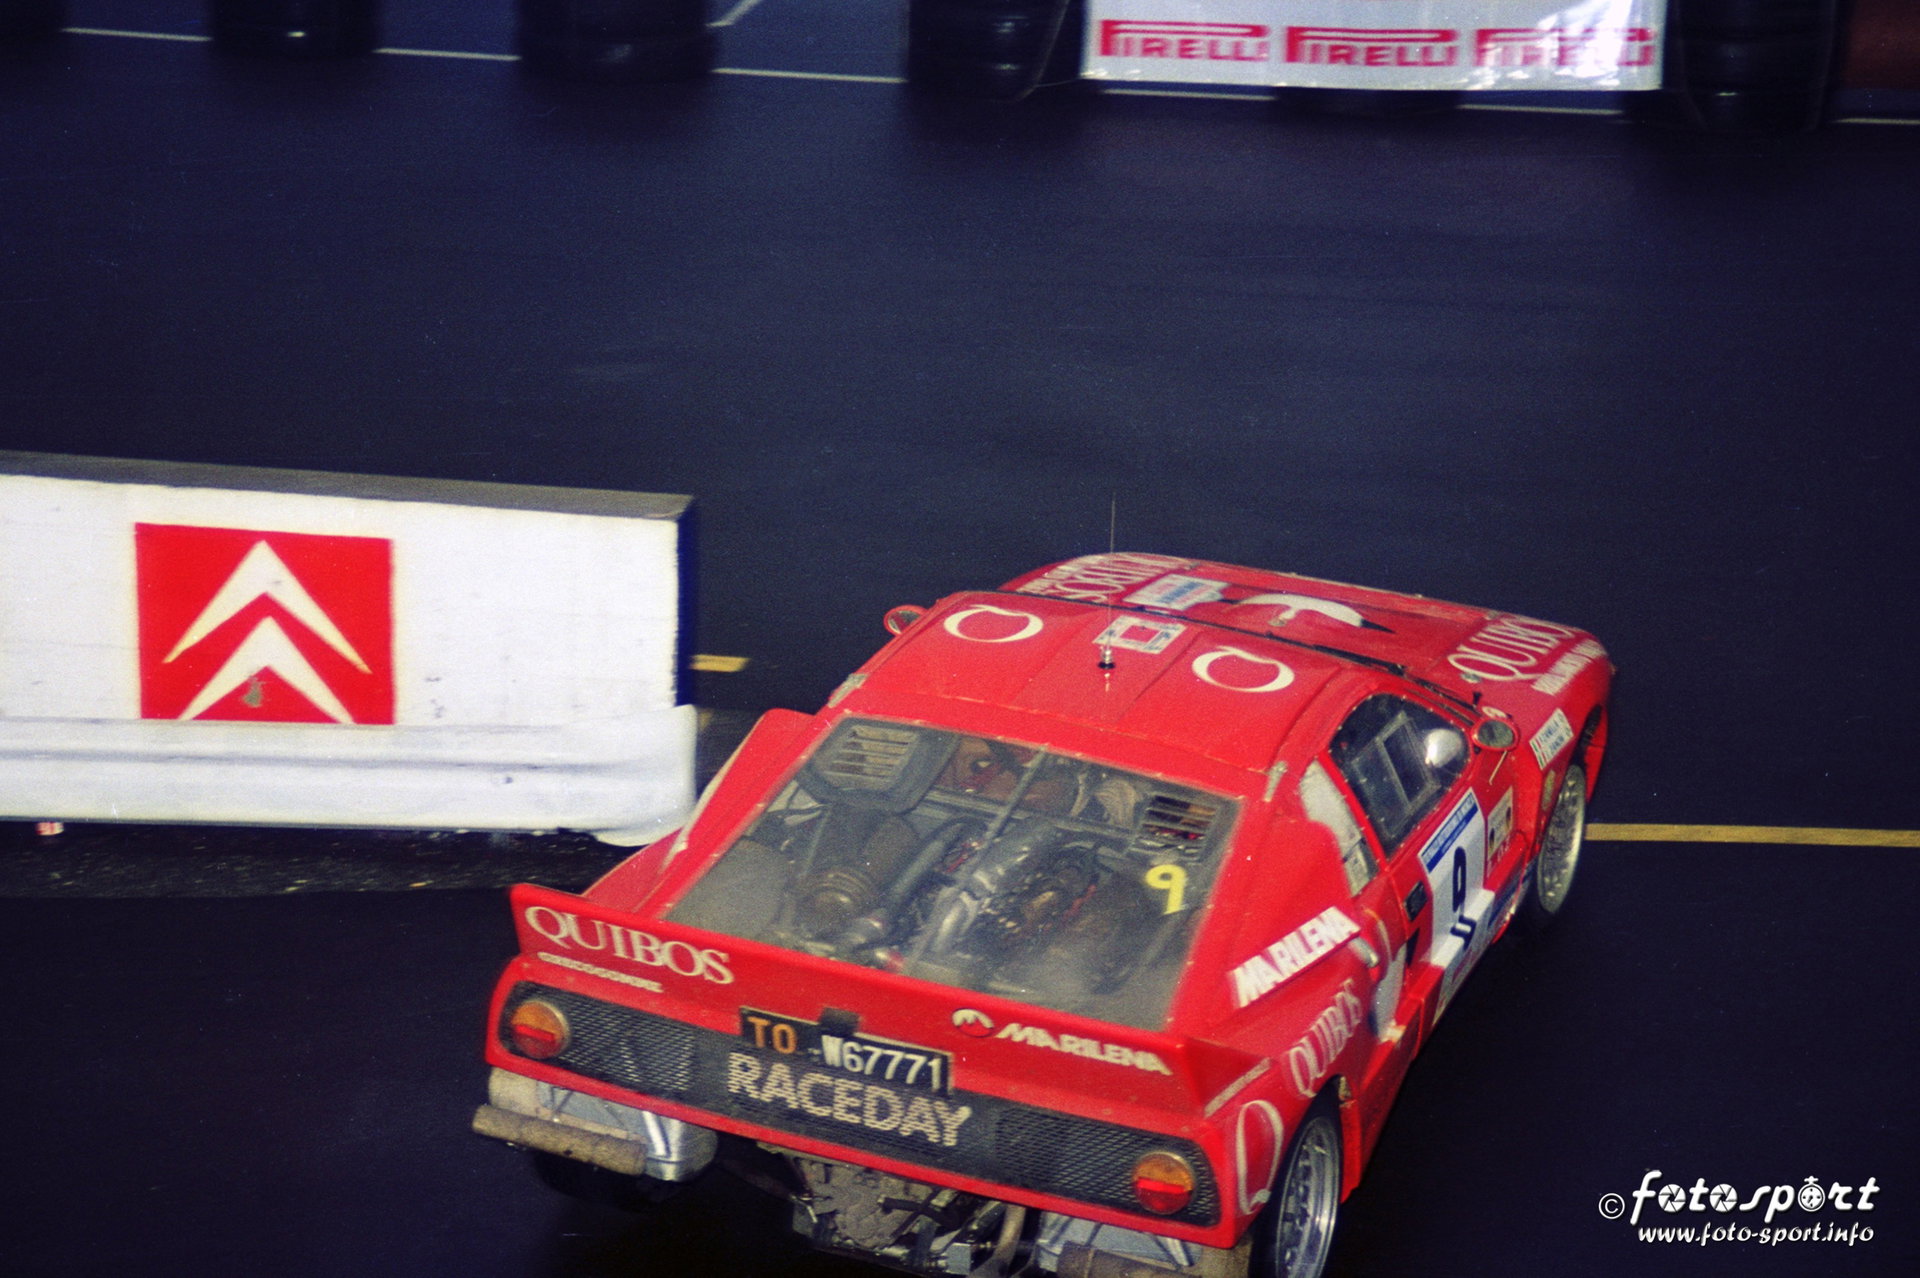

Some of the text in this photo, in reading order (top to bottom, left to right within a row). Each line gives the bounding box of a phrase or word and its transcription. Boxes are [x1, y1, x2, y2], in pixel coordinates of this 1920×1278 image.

[1101, 20, 1268, 62] PIRELLI
[1286, 27, 1456, 66] PIRELLI
[1144, 864, 1188, 915] 9
[524, 906, 735, 984] QUIBOS
[1233, 905, 1361, 1008] MARILENA
[747, 1016, 942, 1091] TO W67771
[996, 1023, 1173, 1076] MARILENA
[727, 1052, 972, 1146] RACEDAY
